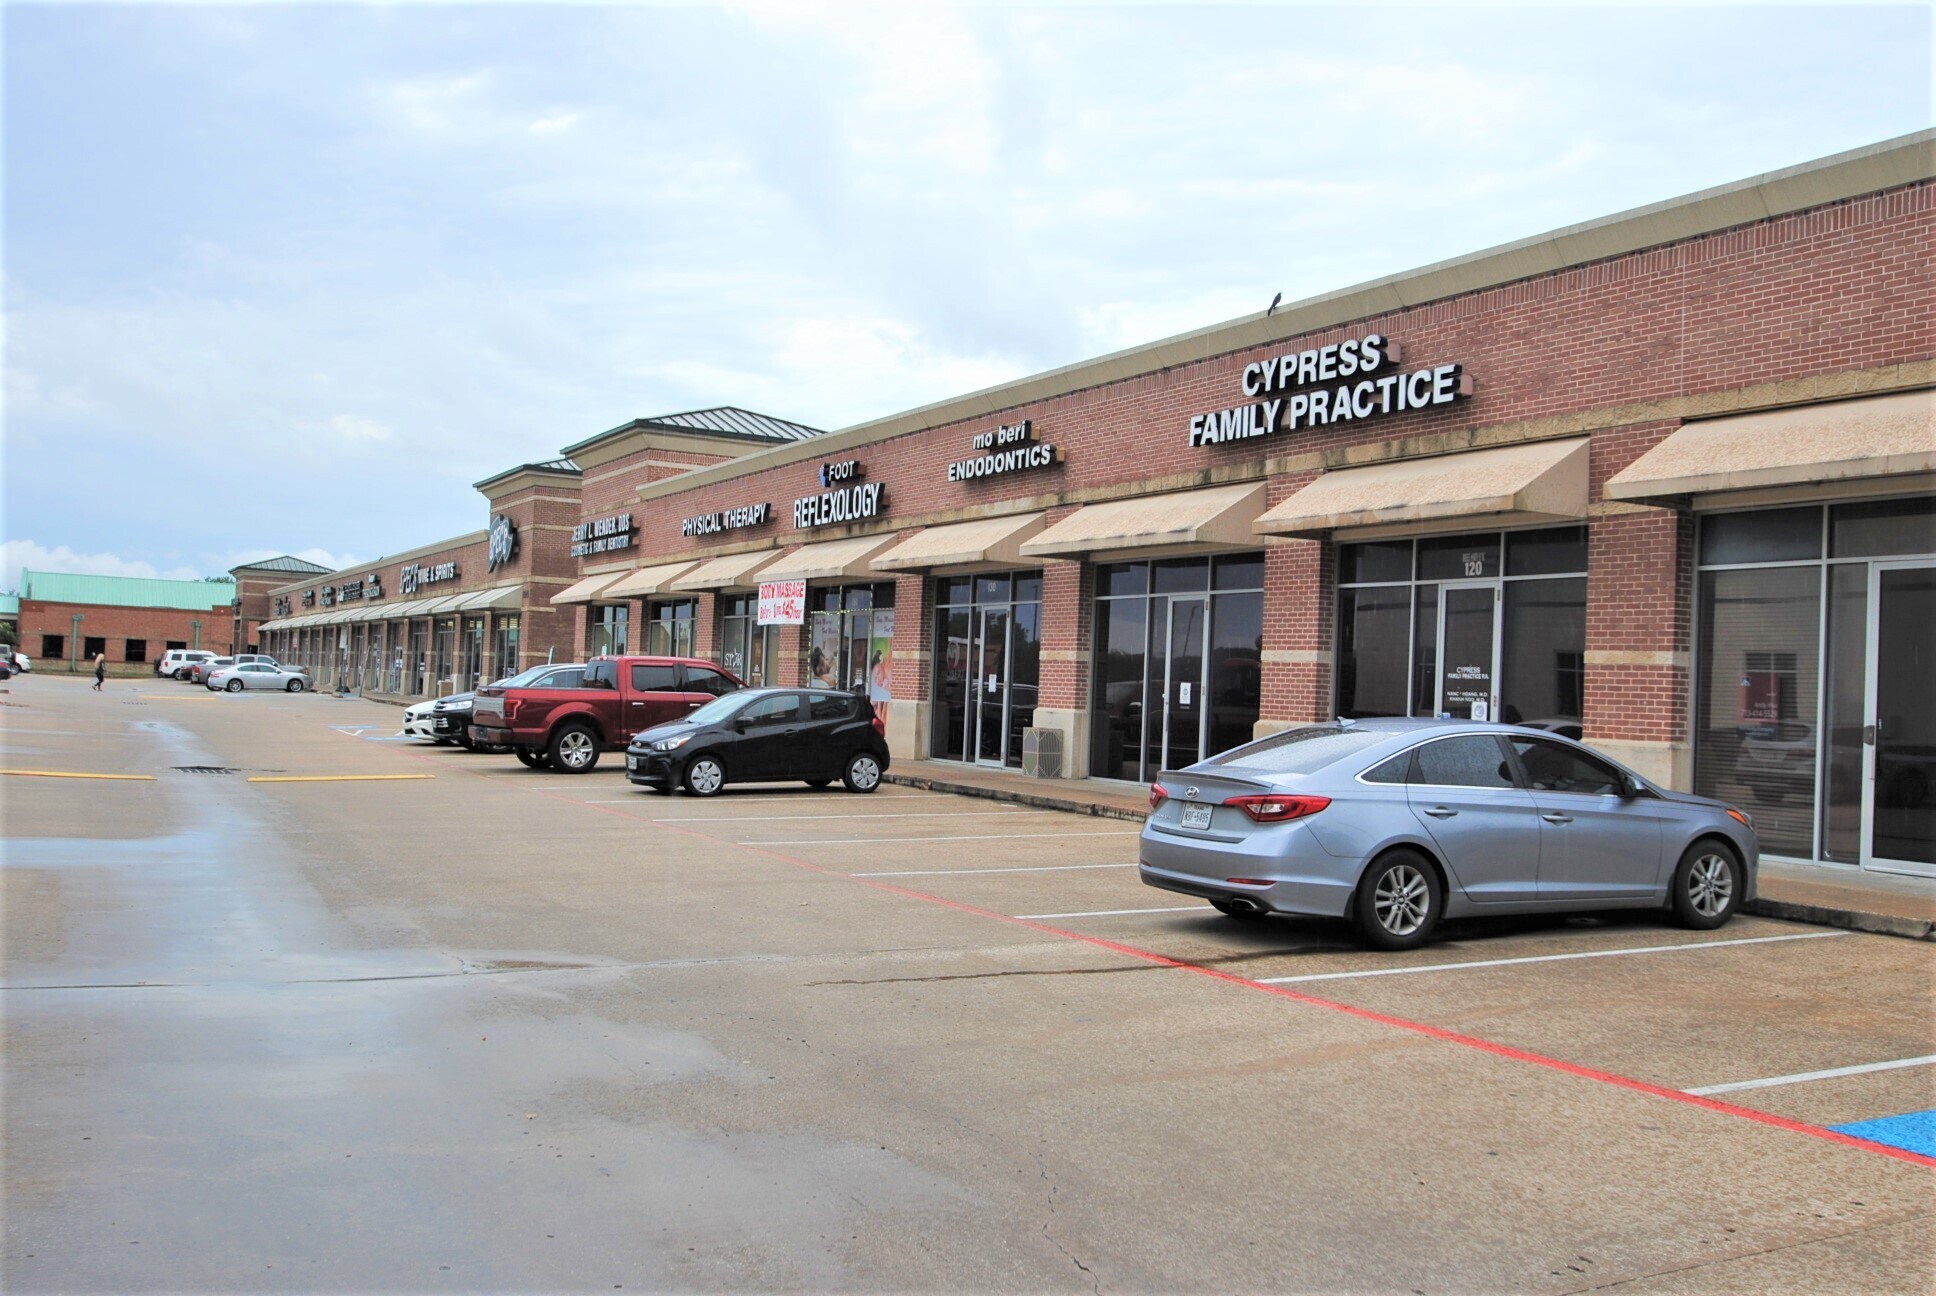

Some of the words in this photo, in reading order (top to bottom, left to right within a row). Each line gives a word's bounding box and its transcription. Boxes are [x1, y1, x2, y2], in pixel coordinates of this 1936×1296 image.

[1241, 334, 1382, 397] CYPRESS
[1189, 399, 1281, 447] FAMILY
[1289, 364, 1457, 429] PRACTICE
[972, 429, 993, 450] mo
[997, 419, 1026, 445] beri
[828, 460, 855, 481] FOOT
[948, 444, 1051, 482] ENDODONTICS
[793, 483, 882, 529] REFLEXOLOGY
[618, 513, 630, 532] DDS
[682, 513, 722, 536] PHYSICAL
[725, 503, 768, 529] THERAPY
[435, 561, 455, 581] SPIRITS
[1464, 560, 1483, 577] 120
[776, 581, 805, 598] MASSAGE
[1456, 666, 1480, 674] CYPRESS
